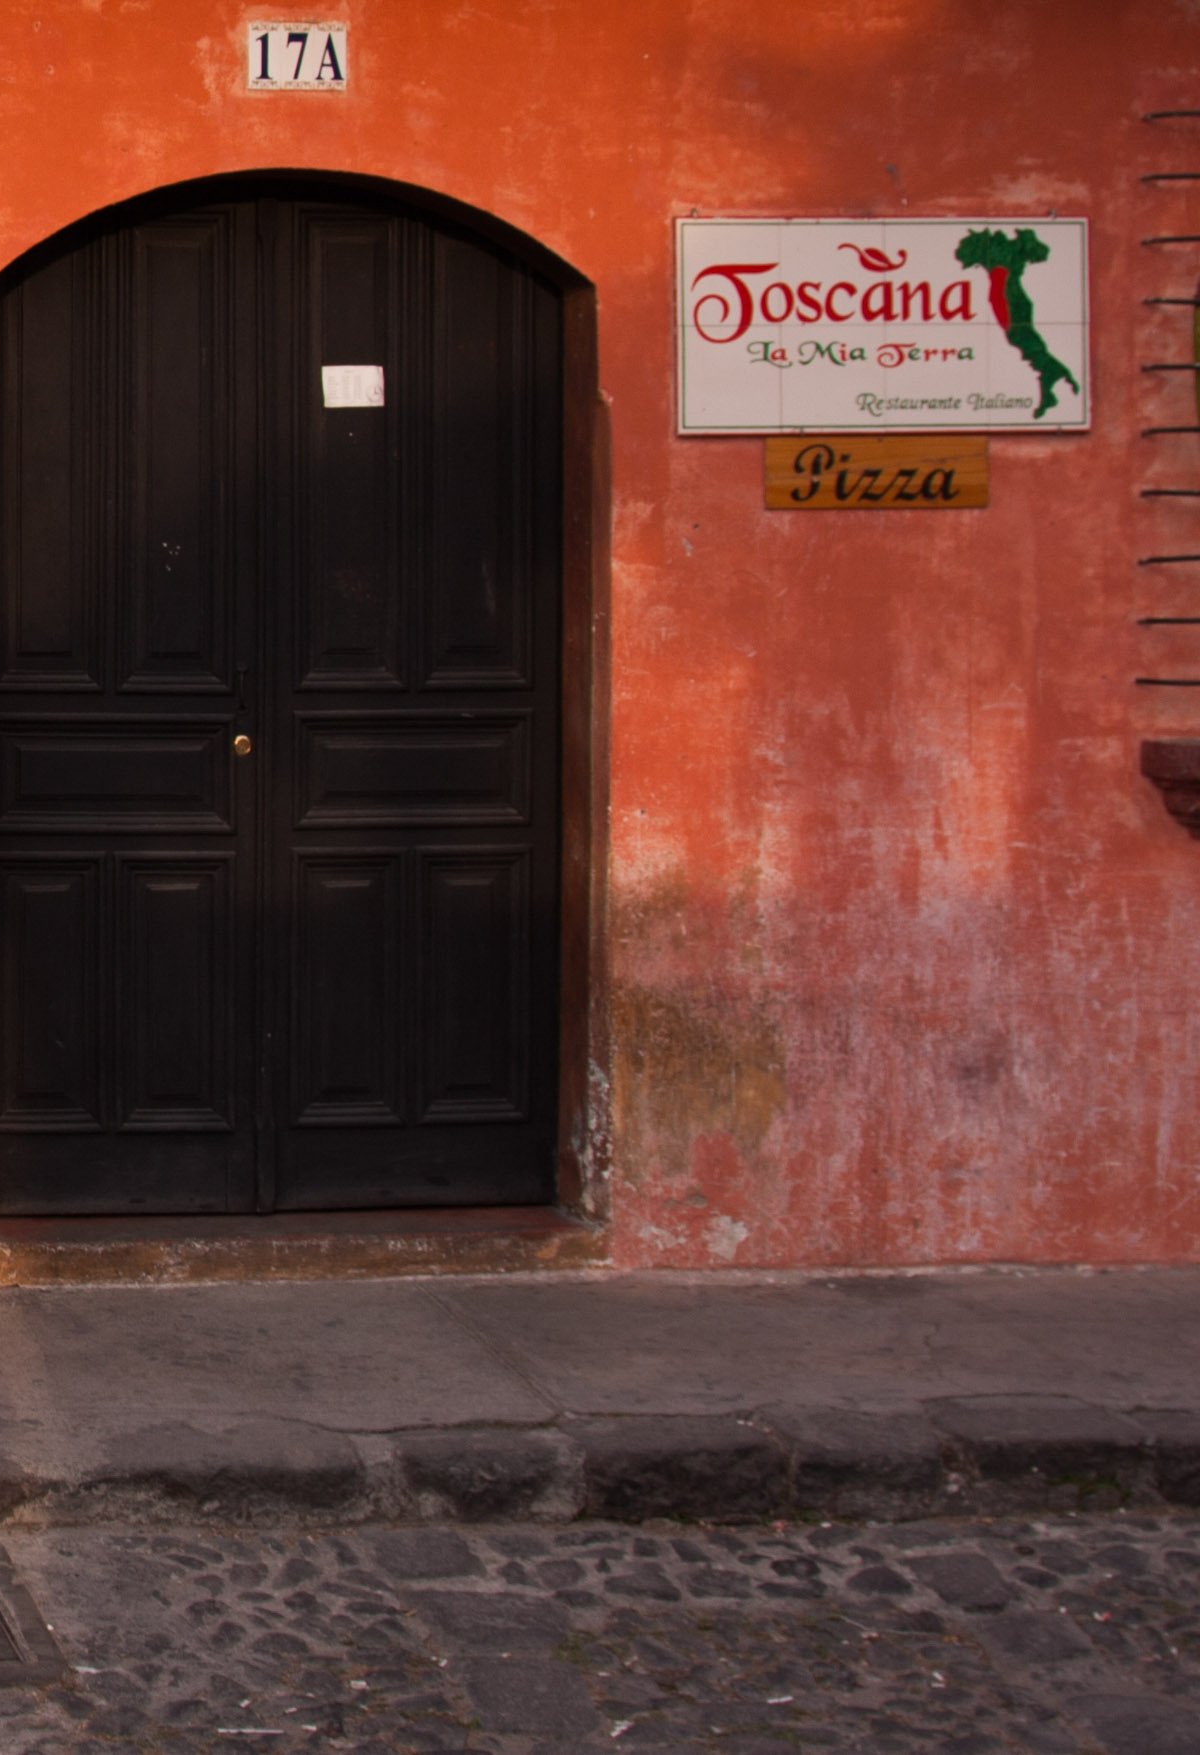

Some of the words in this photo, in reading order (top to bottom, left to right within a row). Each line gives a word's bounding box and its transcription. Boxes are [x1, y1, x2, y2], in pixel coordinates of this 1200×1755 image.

[255, 32, 344, 80] 17A
[691, 262, 977, 344] Toscana
[746, 341, 793, 368] La
[798, 340, 866, 367] Mia
[876, 342, 974, 369] Terra
[856, 392, 962, 417] Restaurante
[967, 392, 1033, 411] Italiano
[790, 443, 960, 502] Pizza
